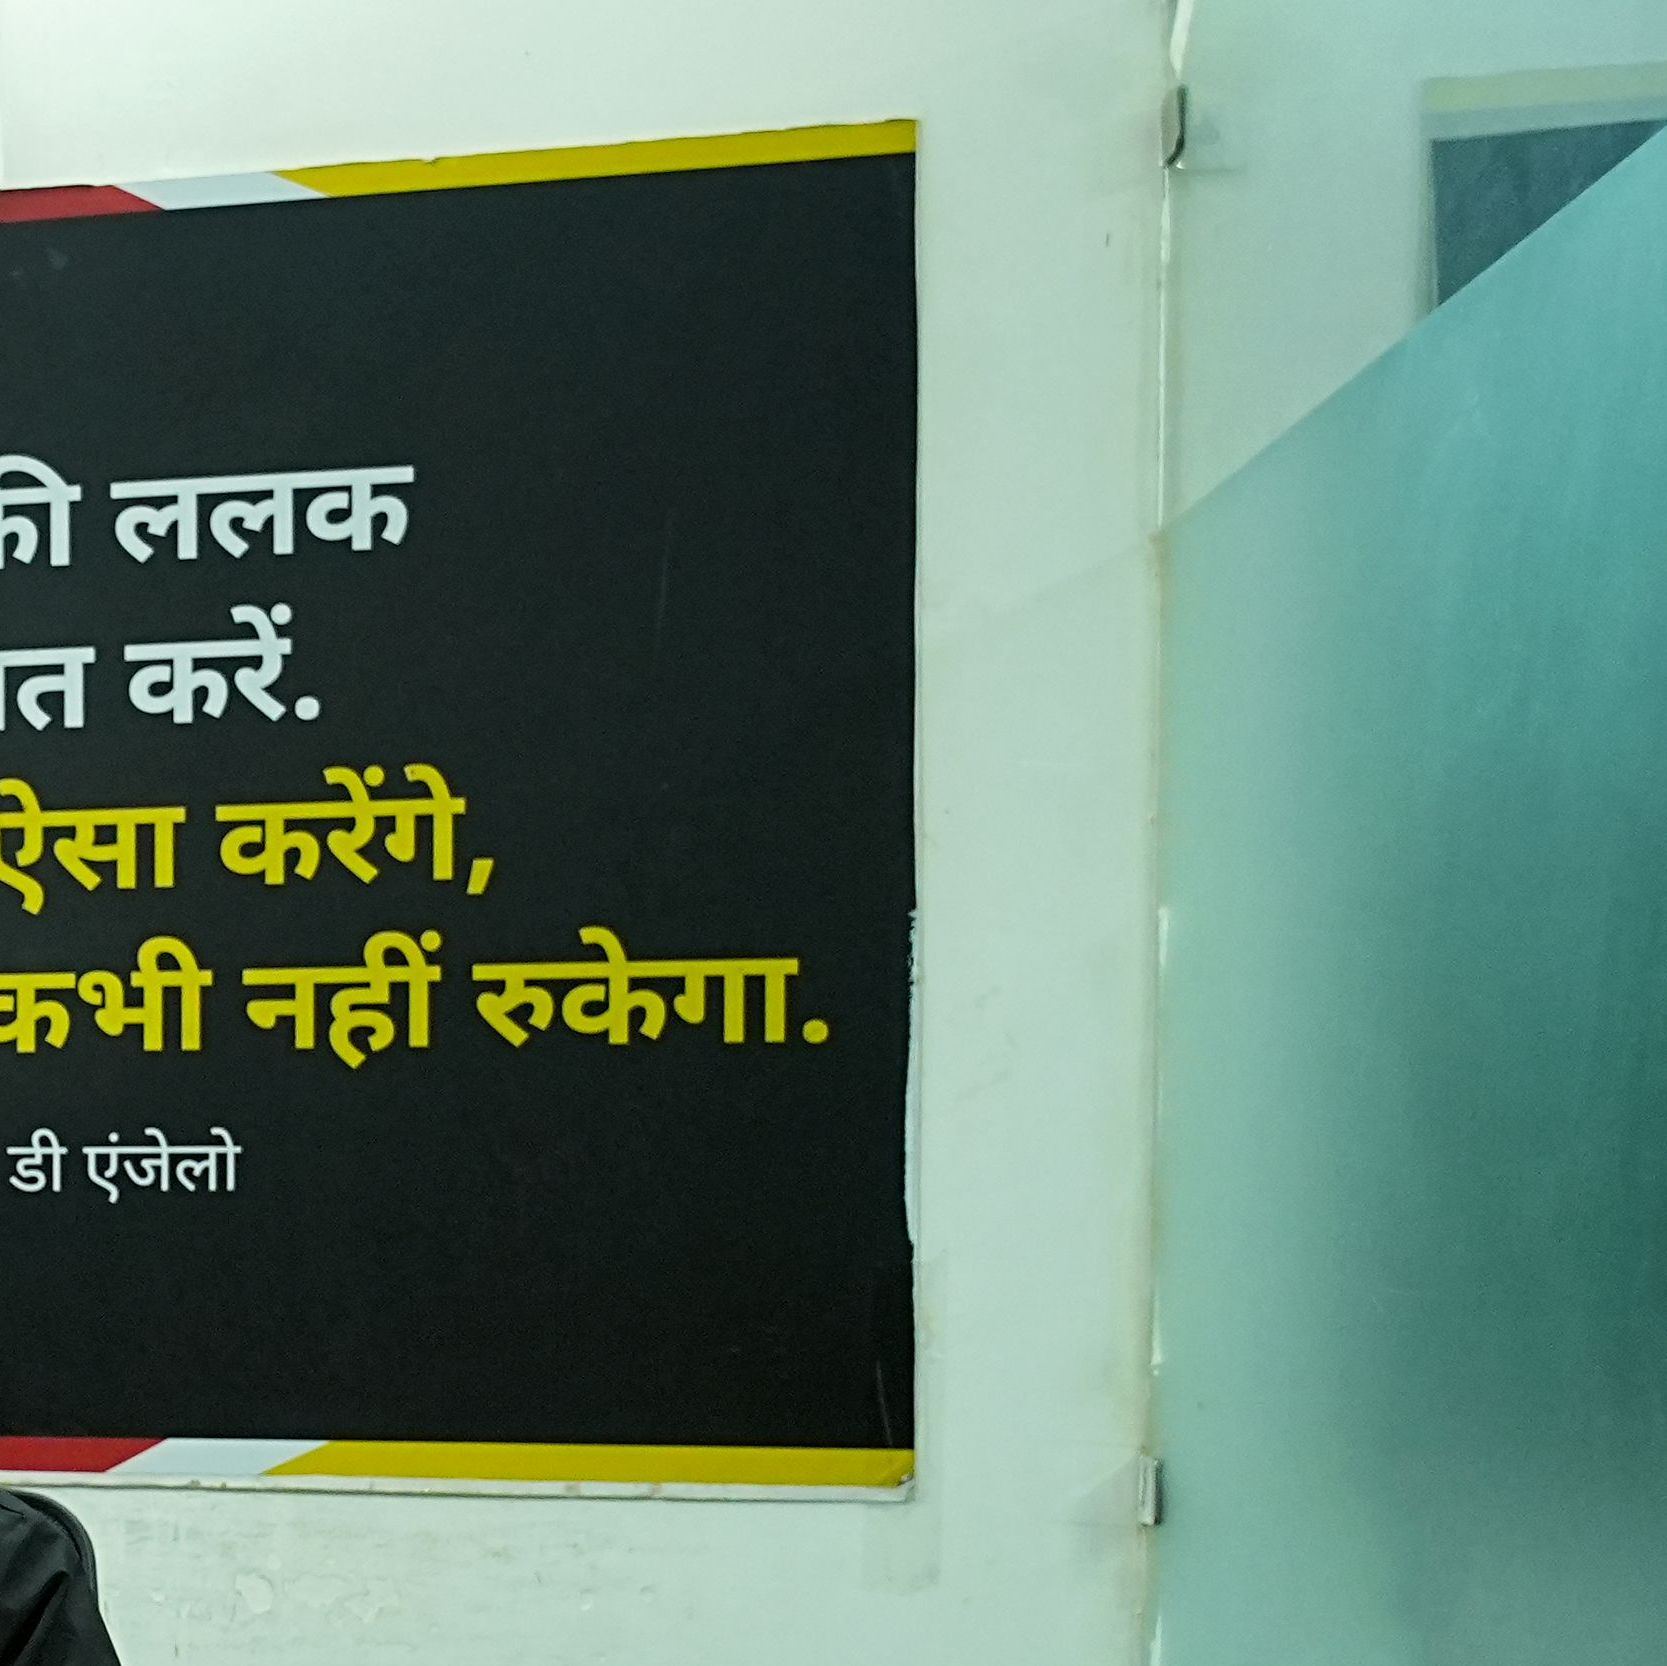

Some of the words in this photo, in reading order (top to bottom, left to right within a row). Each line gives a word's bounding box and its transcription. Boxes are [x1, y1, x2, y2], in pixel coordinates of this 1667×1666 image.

[110, 464, 414, 563] ललक
[124, 603, 320, 724] करें.
[216, 763, 495, 895] करेंगे,
[243, 930, 441, 1069] नहीं
[473, 926, 830, 1047] रुकेगा.
[6, 1127, 69, 1192] डी
[82, 1126, 242, 1204] एंजेलो
